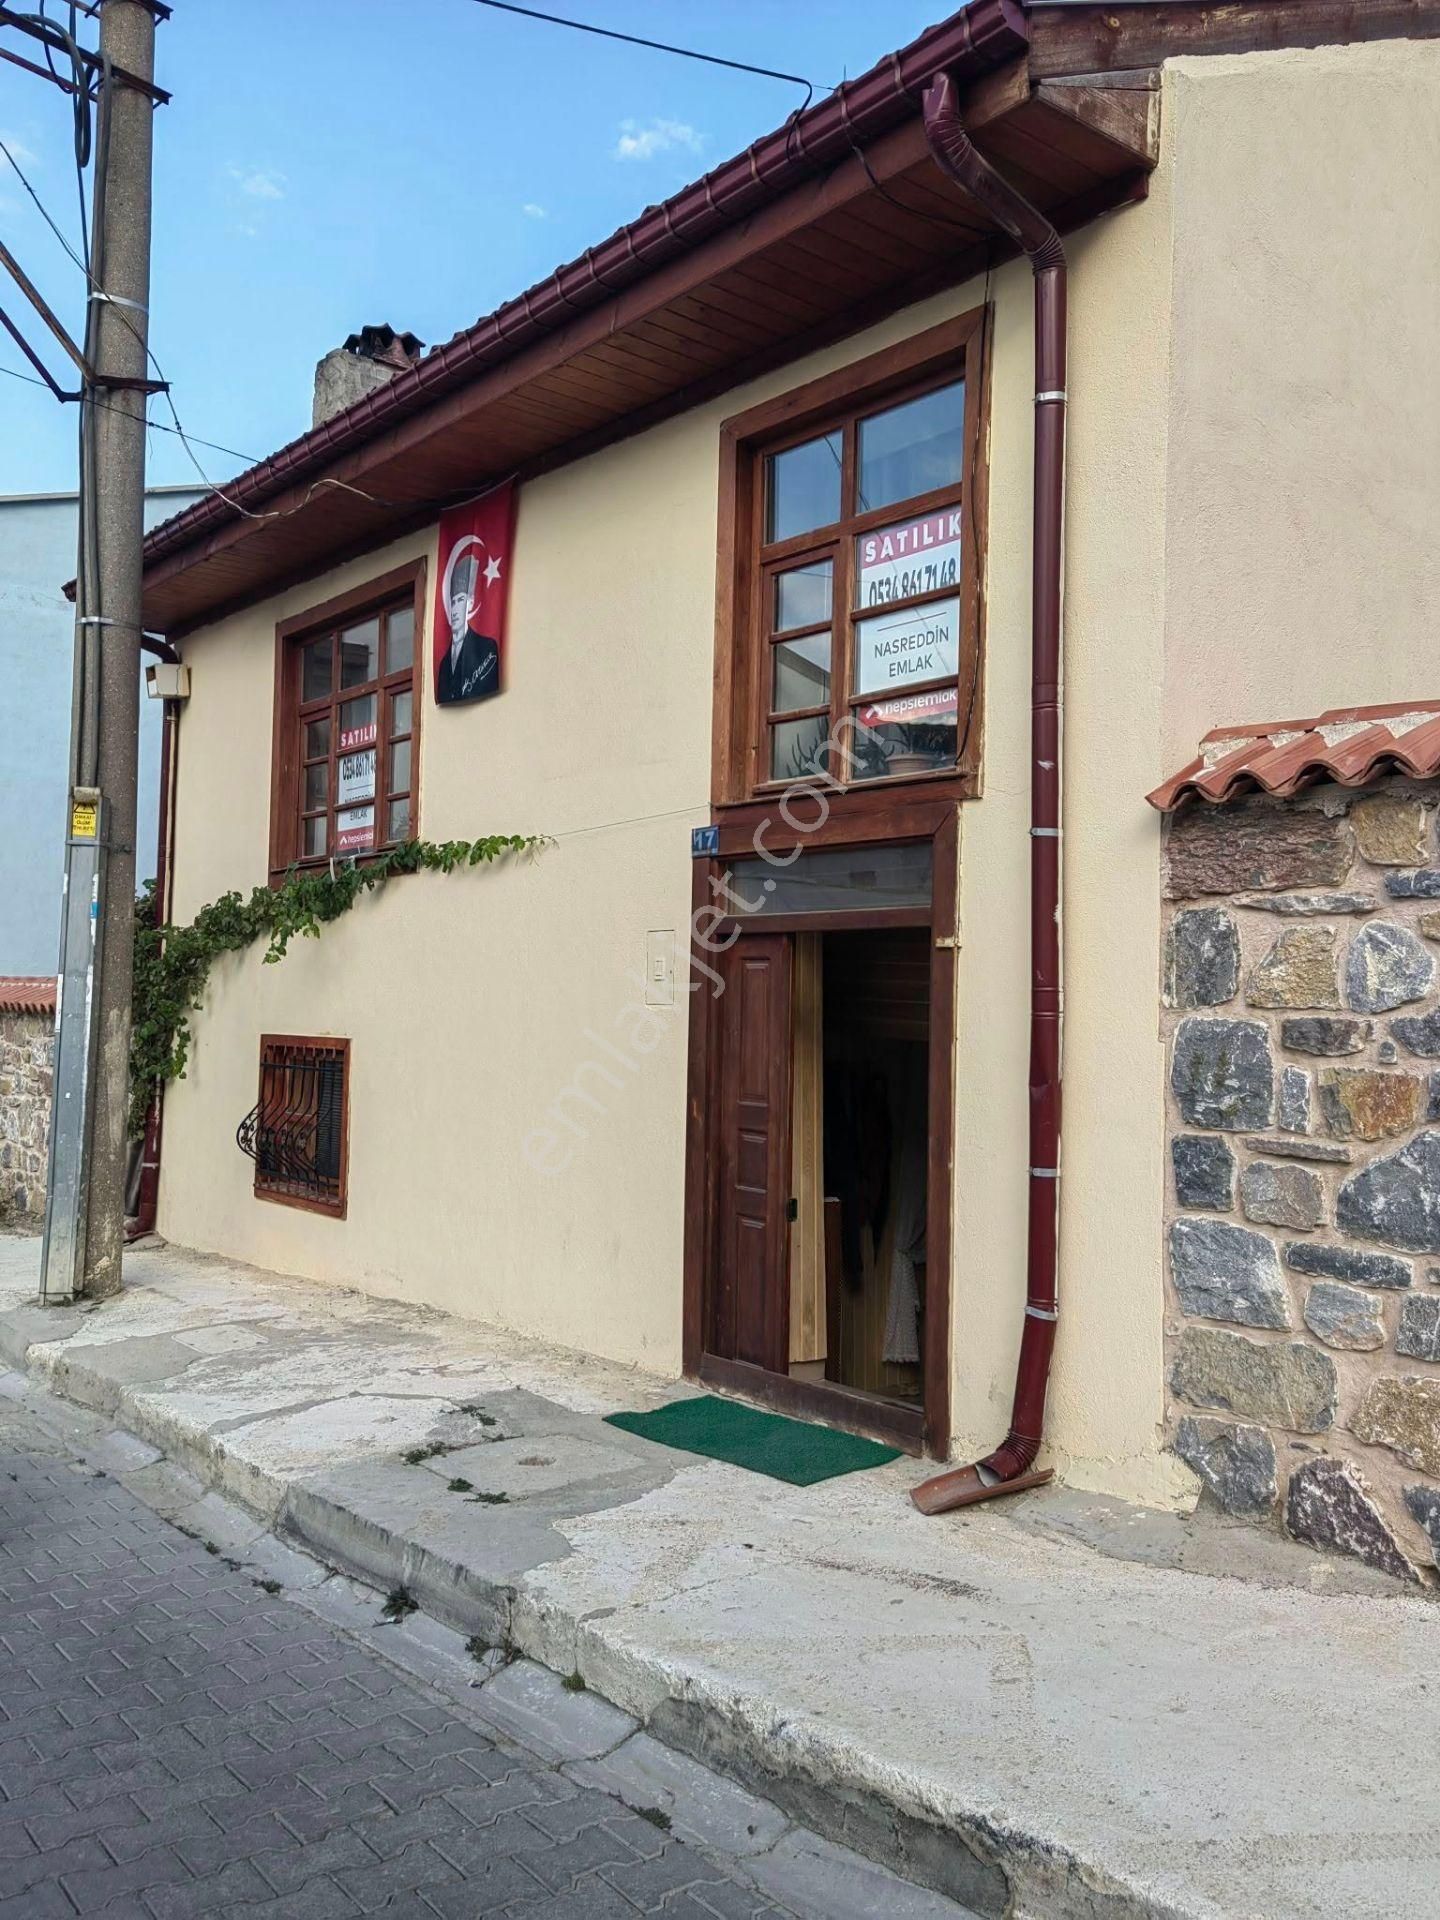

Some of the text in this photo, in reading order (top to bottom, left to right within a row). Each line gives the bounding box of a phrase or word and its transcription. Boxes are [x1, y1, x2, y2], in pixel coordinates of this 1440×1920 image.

[865, 511, 961, 563] SATILIK
[874, 625, 949, 659] NASREDDİN
[888, 653, 933, 678] EMLAK
[695, 830, 715, 850] 17
